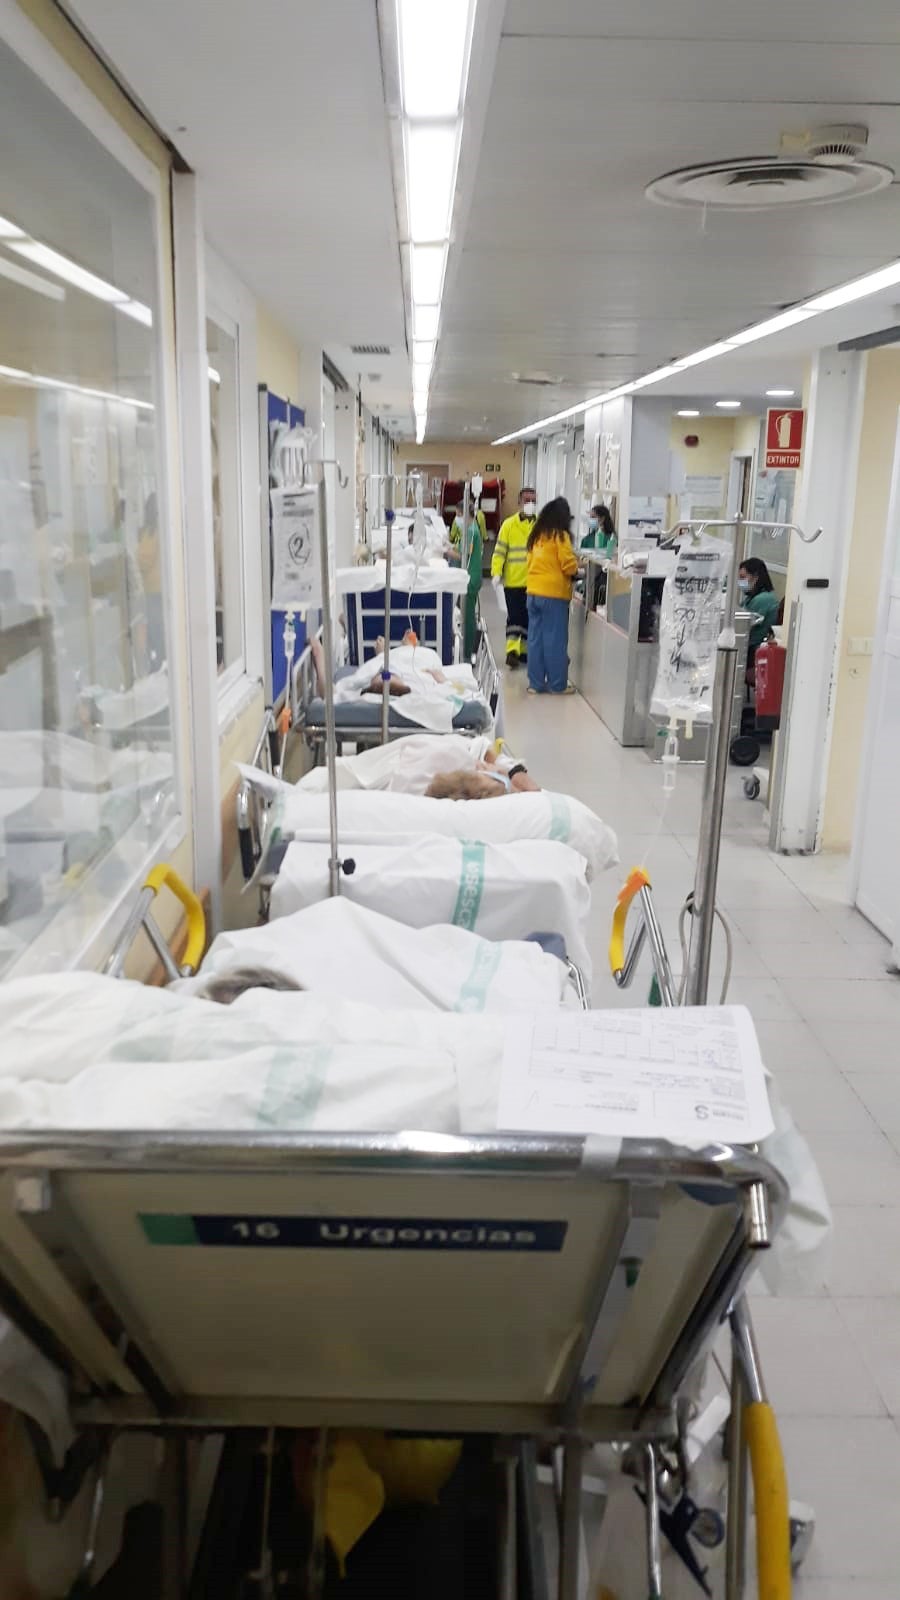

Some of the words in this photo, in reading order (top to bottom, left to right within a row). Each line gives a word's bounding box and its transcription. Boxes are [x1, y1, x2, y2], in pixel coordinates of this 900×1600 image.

[767, 455, 799, 464] EXTINTOR
[231, 1221, 280, 1239] 16
[319, 1223, 537, 1245] Urgencias
